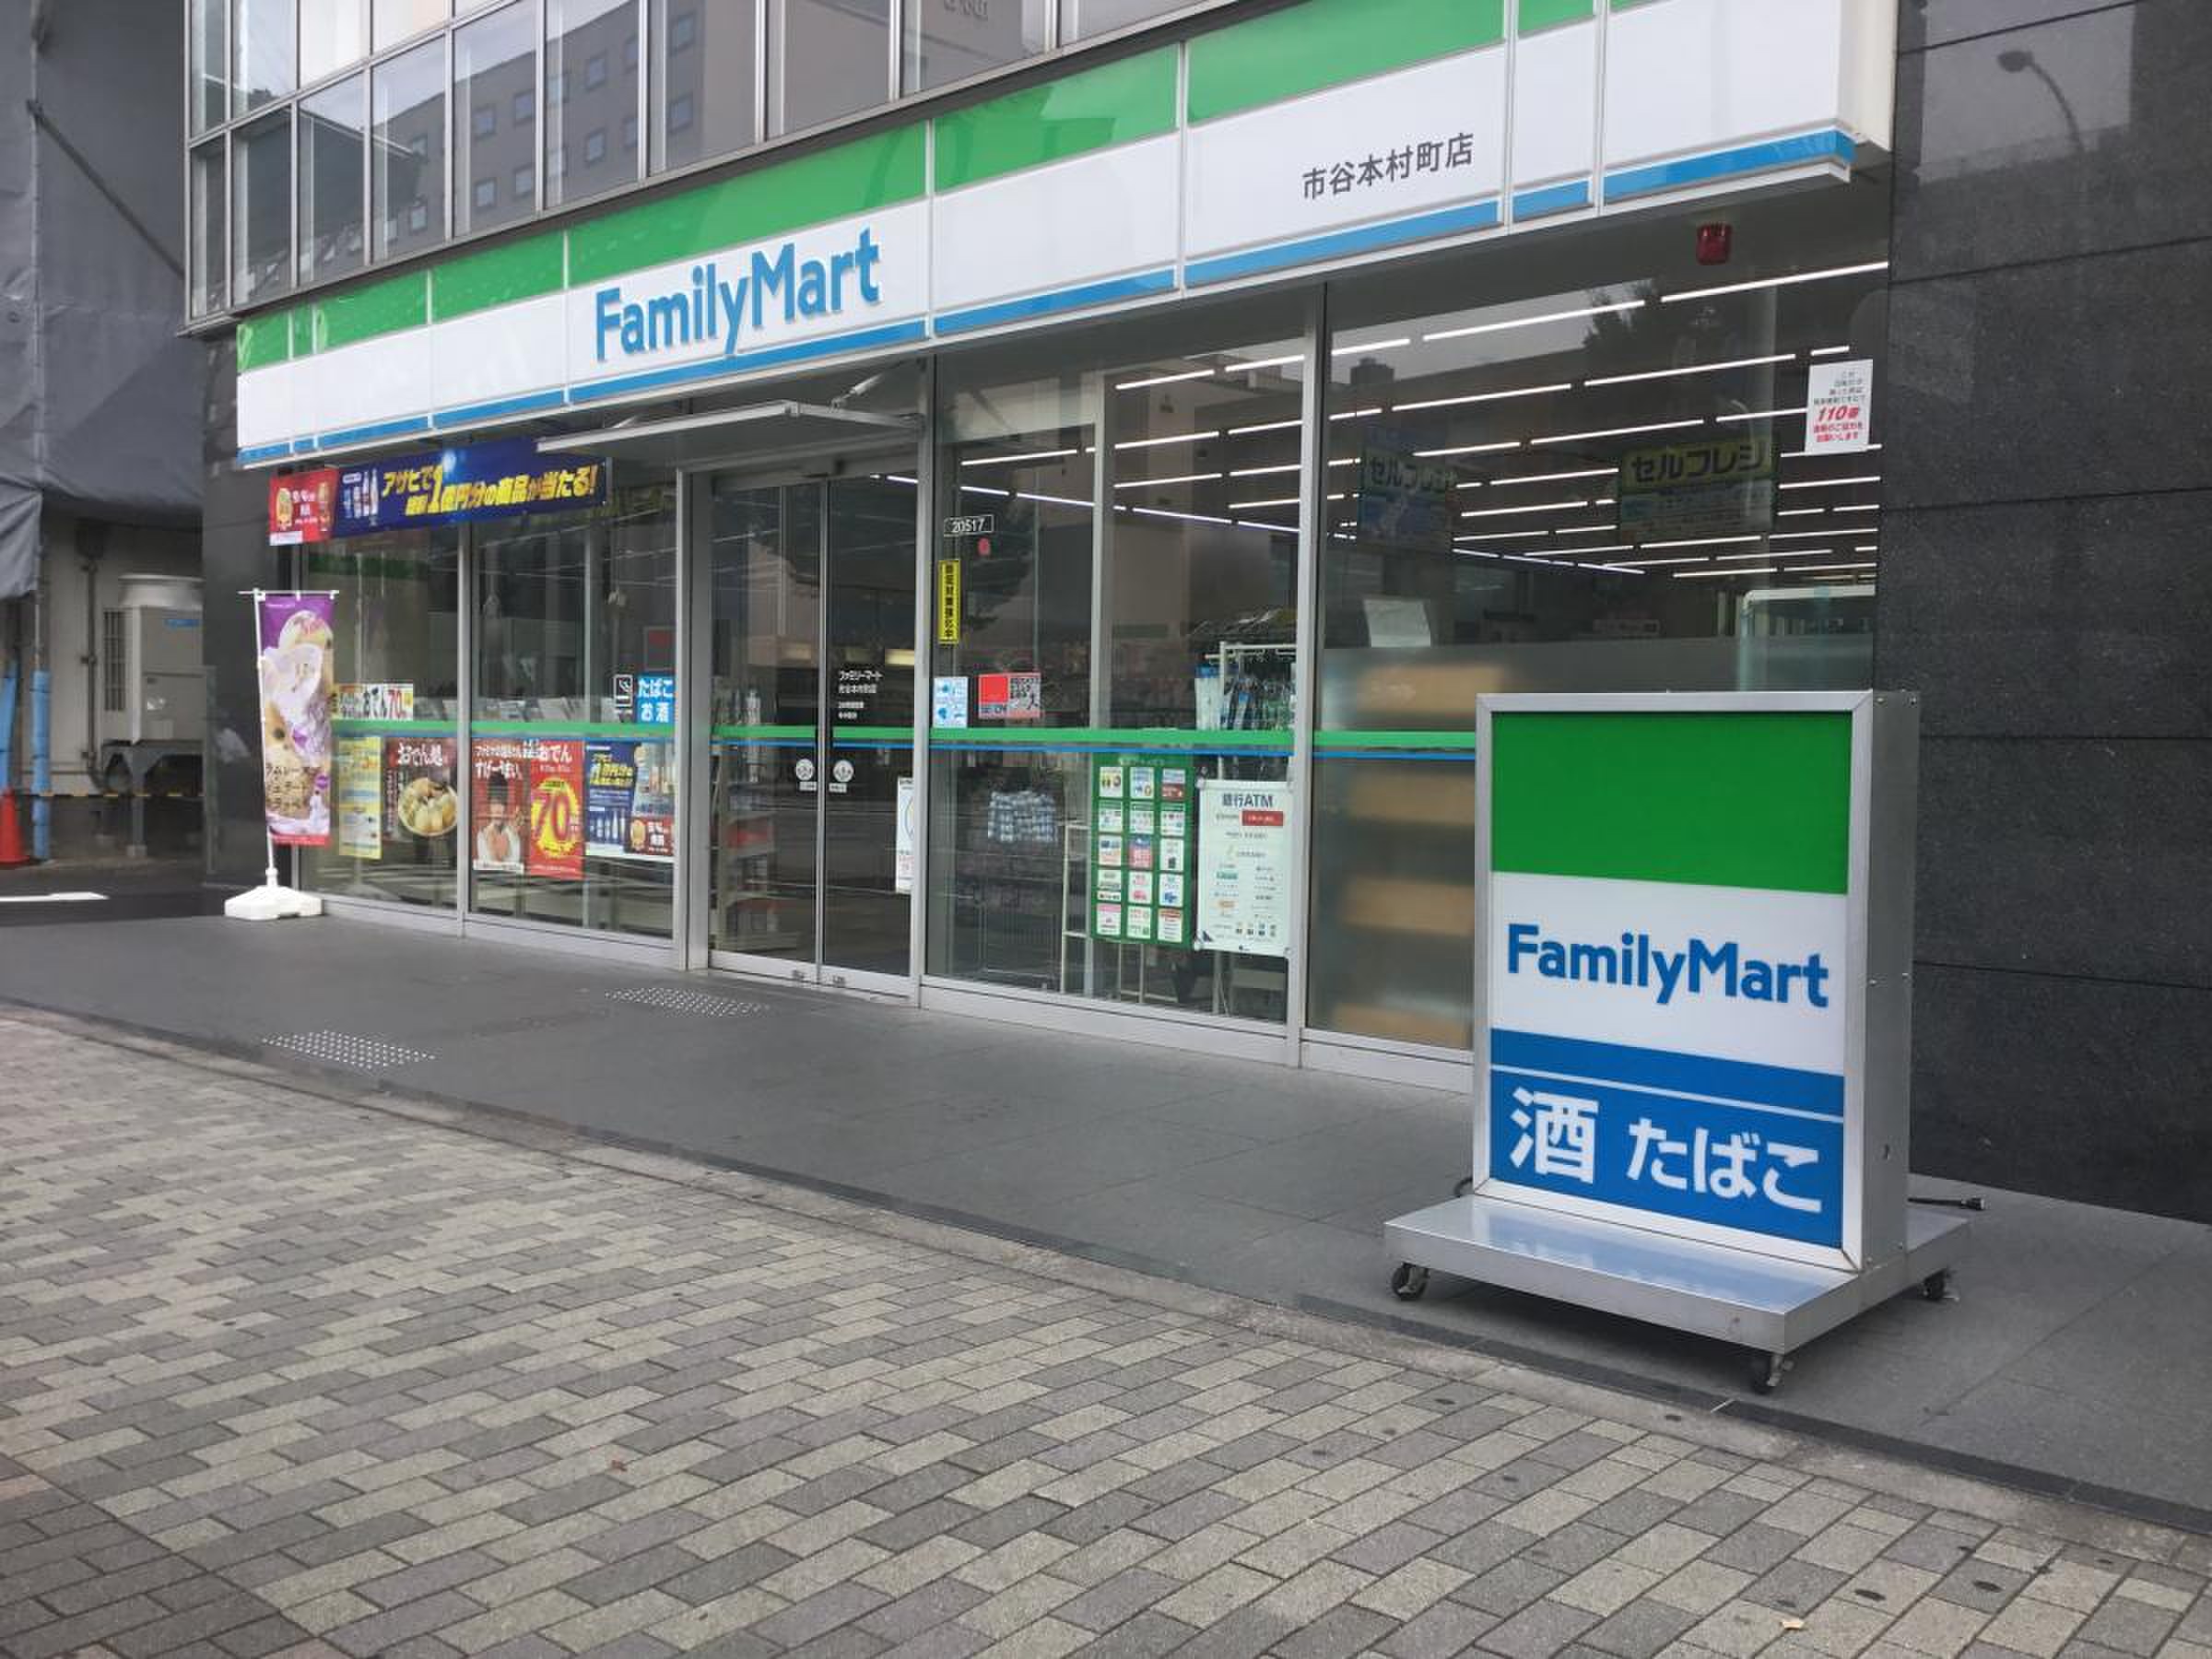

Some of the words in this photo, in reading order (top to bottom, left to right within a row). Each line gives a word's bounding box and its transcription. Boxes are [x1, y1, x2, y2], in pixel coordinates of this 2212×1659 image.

[1301, 132, 1474, 200] 市谷本村町店
[595, 227, 881, 362] FamilyMart
[1630, 441, 1767, 483] セルフレジ
[638, 677, 674, 698] たばこ
[1222, 793, 1273, 807] 銀行ATM
[1507, 923, 1830, 1007] FamilyMart
[1509, 1087, 1599, 1184] 酒
[1627, 1116, 1822, 1214] たばこ
